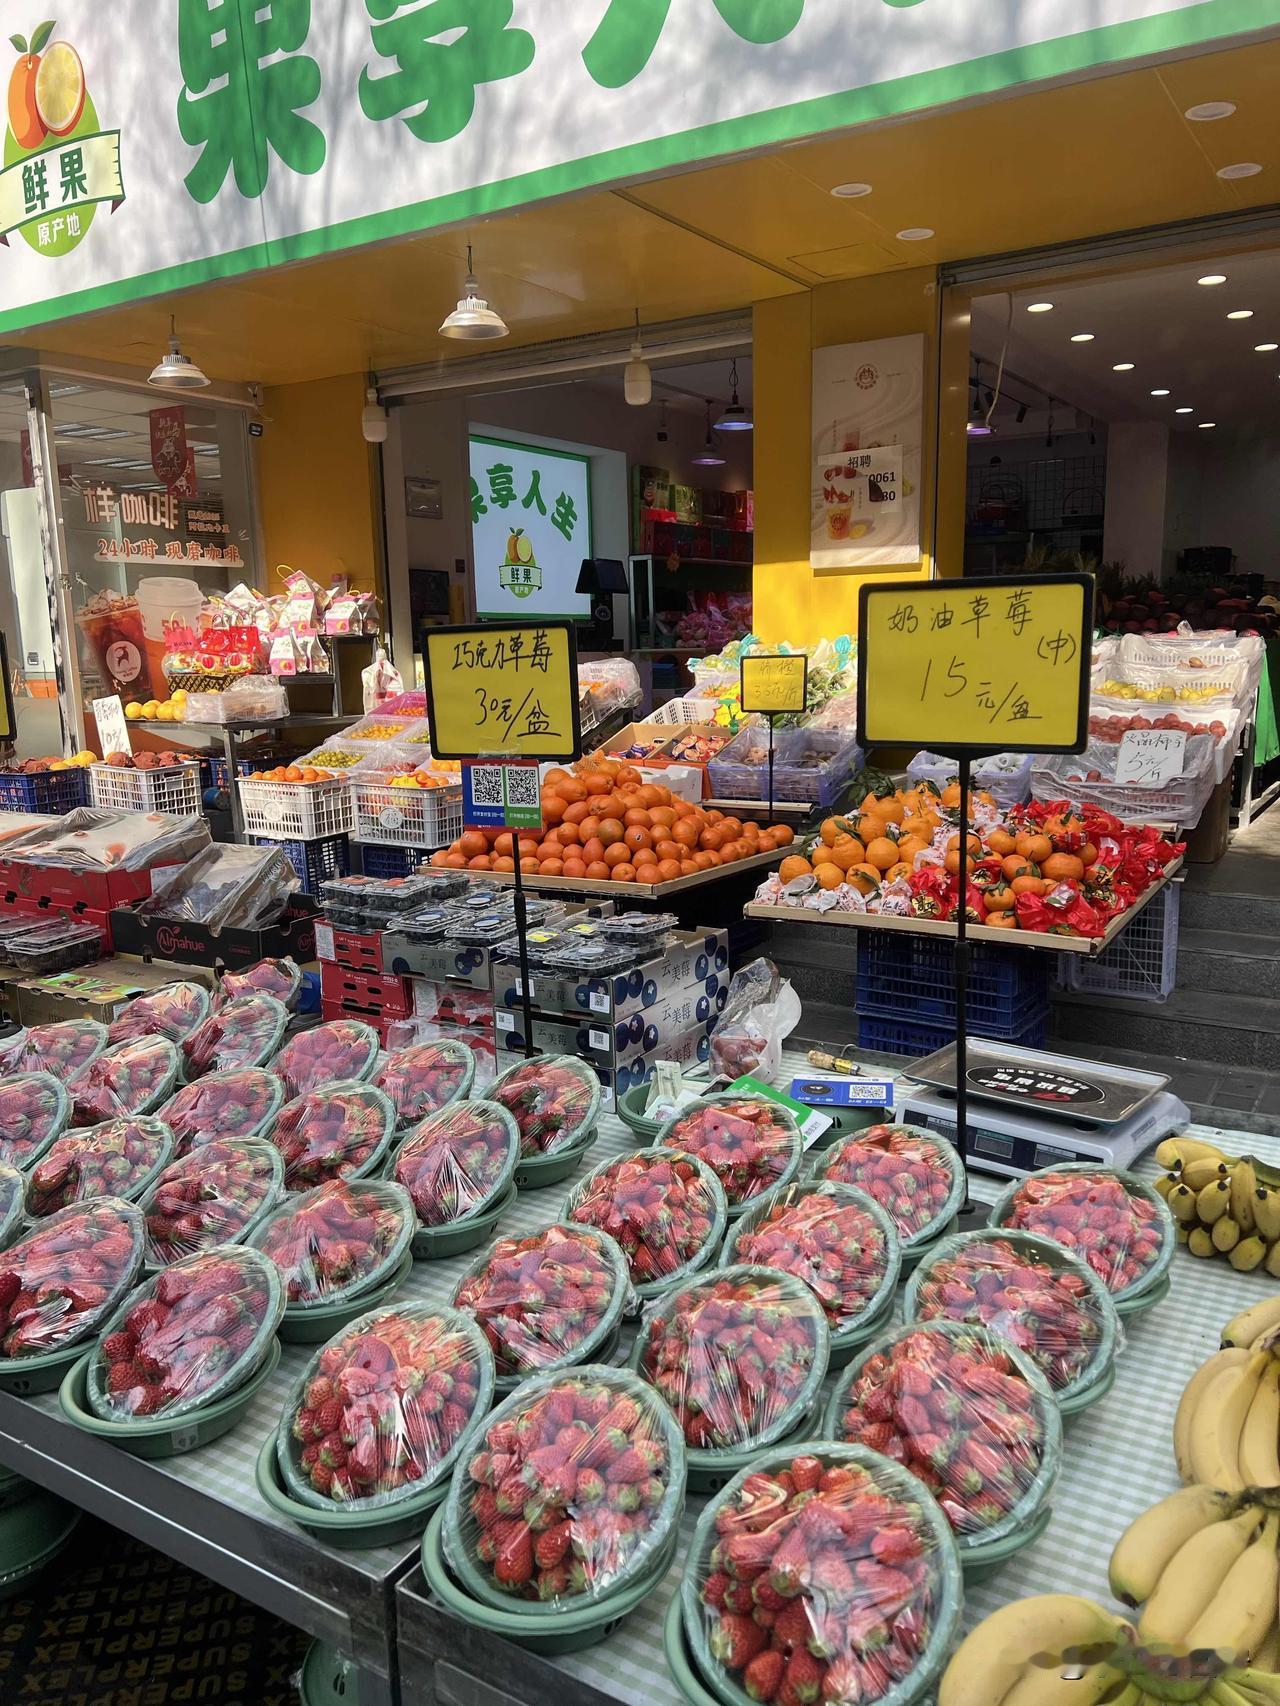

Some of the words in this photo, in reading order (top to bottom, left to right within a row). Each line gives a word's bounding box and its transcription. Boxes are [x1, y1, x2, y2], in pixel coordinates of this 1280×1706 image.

[22, 147, 88, 213] 鲜果
[37, 212, 81, 247] 原产地
[847, 454, 872, 469] 招聘
[866, 471, 896, 484] 0061
[97, 538, 158, 559] 24小时
[166, 540, 241, 562] 现磨咖啡
[510, 567, 532, 583] 鲜果
[888, 589, 1033, 639] 奶油草莓
[1036, 629, 1077, 666] (中)
[452, 629, 553, 673] 巧克力草莓
[1124, 731, 1183, 751] 火晶柿子
[1123, 751, 1169, 783] 5元/斤
[284, 906, 309, 918] ahue
[157, 926, 205, 954] Almahue
[40, 1592, 240, 1639] UPERPLEX
[31, 1615, 256, 1665] SUPERPLEX
[19, 1641, 253, 1694] SUPERPLEX
